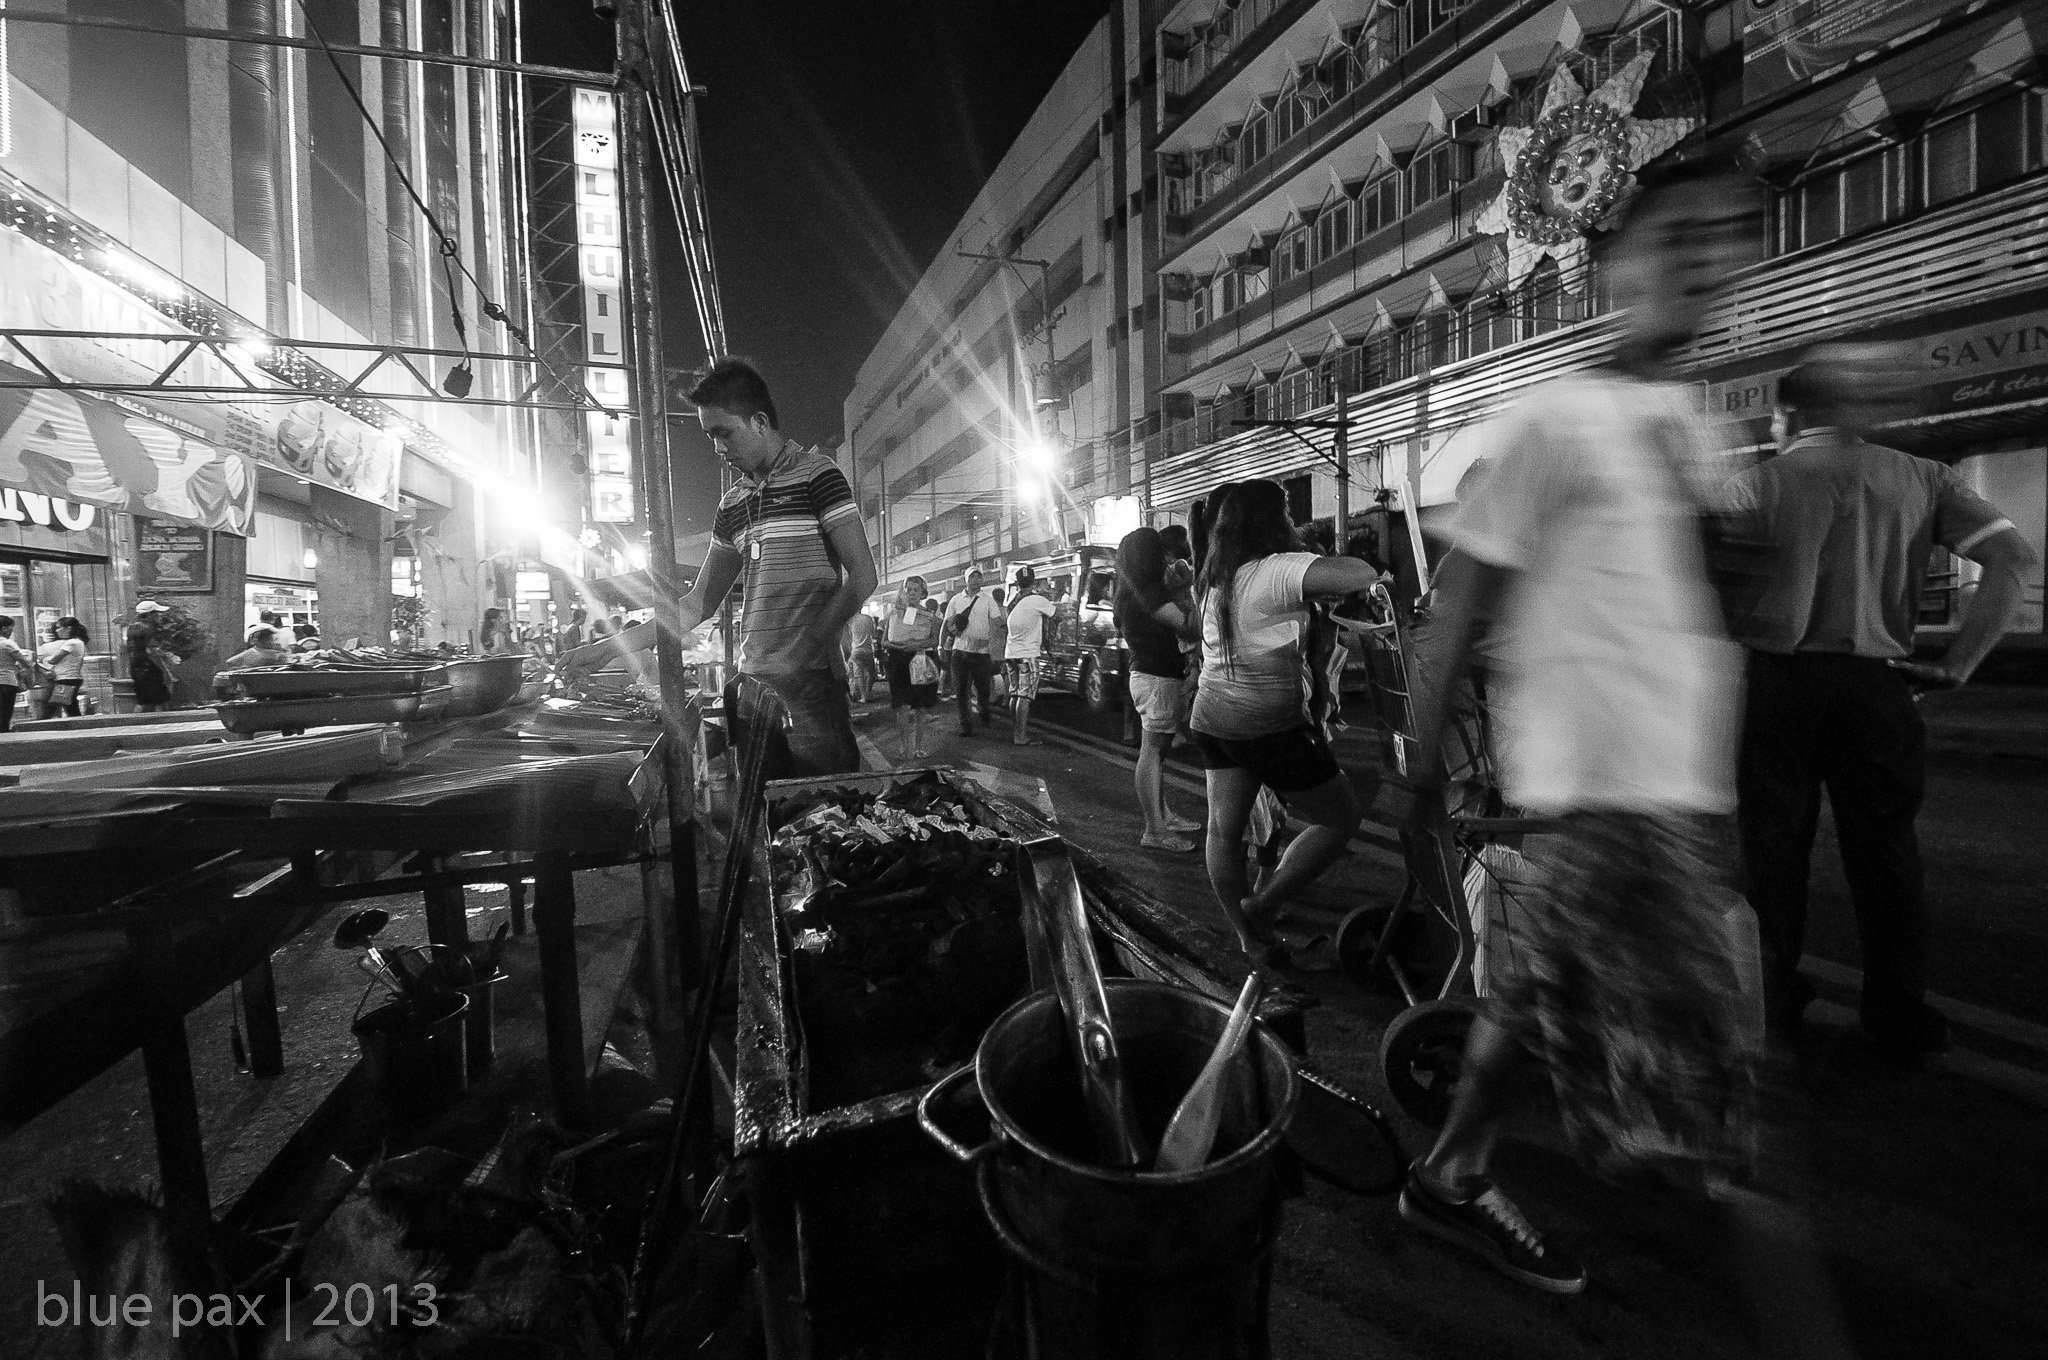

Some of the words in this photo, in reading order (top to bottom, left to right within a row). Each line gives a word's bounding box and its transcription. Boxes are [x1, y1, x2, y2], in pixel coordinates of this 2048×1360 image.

[1724, 384, 1770, 412] BPI
[1952, 379, 1996, 402] Get
[2002, 374, 2048, 394] sta
